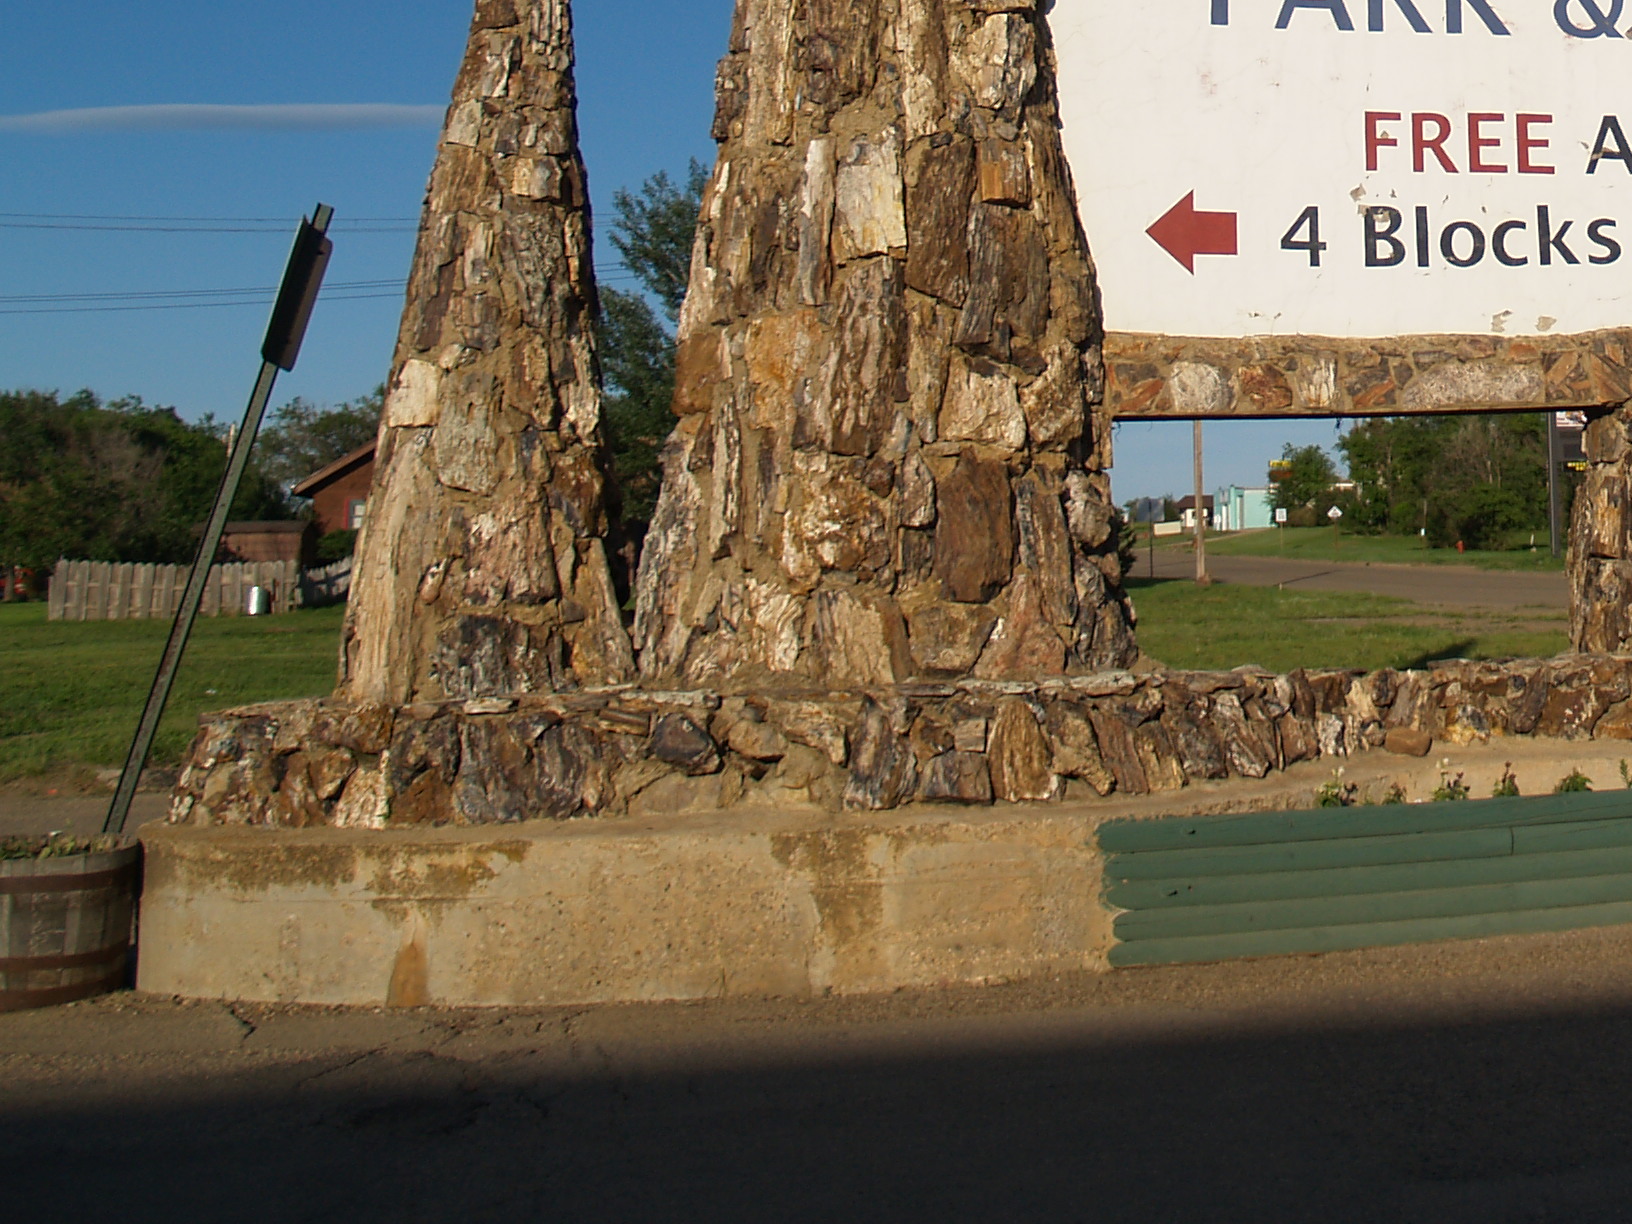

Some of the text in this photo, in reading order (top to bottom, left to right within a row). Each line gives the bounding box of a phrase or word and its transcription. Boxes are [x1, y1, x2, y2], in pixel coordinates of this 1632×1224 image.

[1365, 111, 1556, 174] FREE
[1281, 206, 1327, 267] 4
[1363, 205, 1622, 267] Blocks
